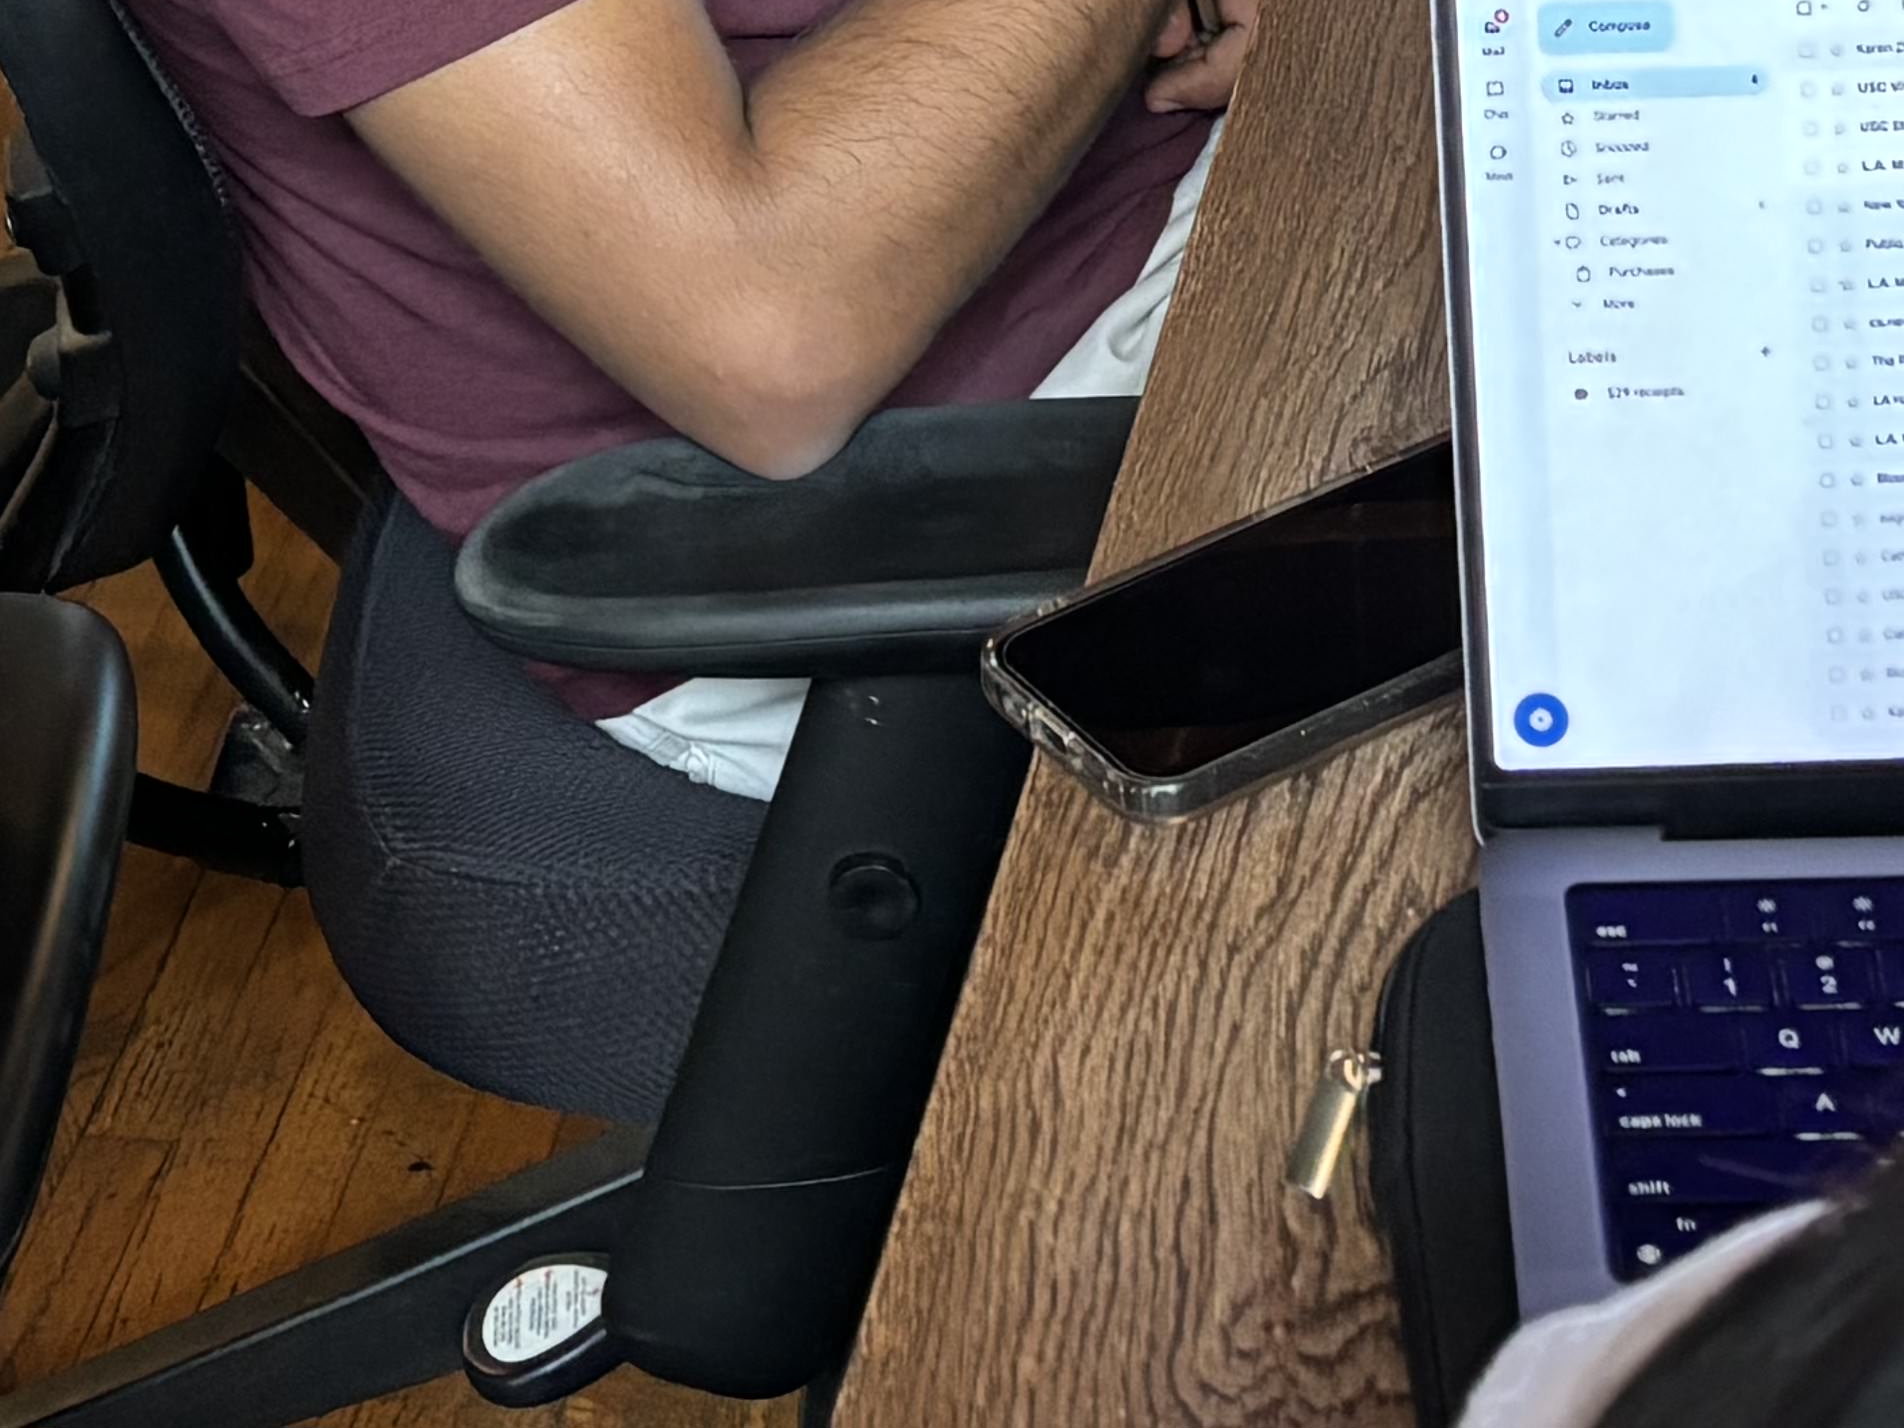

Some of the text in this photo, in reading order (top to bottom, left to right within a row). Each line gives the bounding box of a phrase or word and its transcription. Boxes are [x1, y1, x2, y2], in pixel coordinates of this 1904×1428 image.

[1820, 975, 1838, 994] 2
[1778, 1028, 1800, 1050] Q
[1873, 1025, 1901, 1046] W
[1816, 1092, 1835, 1112] A
